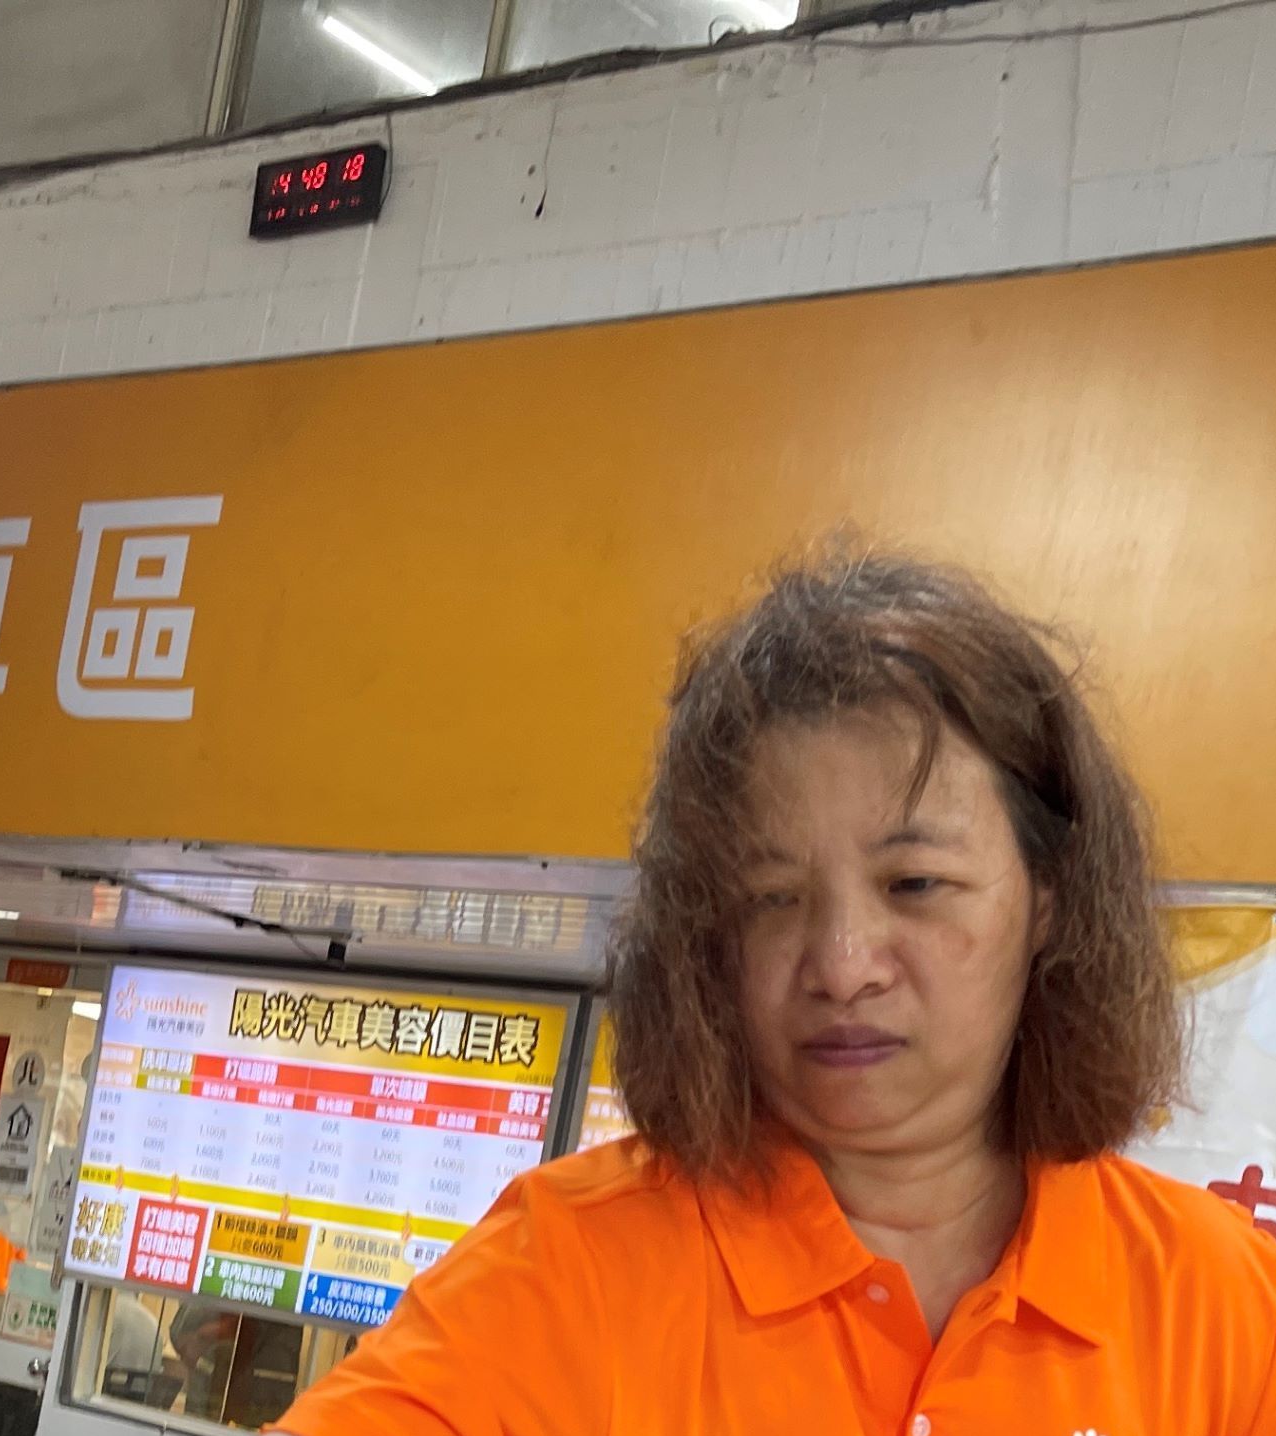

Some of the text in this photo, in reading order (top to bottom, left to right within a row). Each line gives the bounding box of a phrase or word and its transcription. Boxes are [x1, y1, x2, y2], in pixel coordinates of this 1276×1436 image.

[227, 988, 540, 1069] 陽光汽車美容價目表
